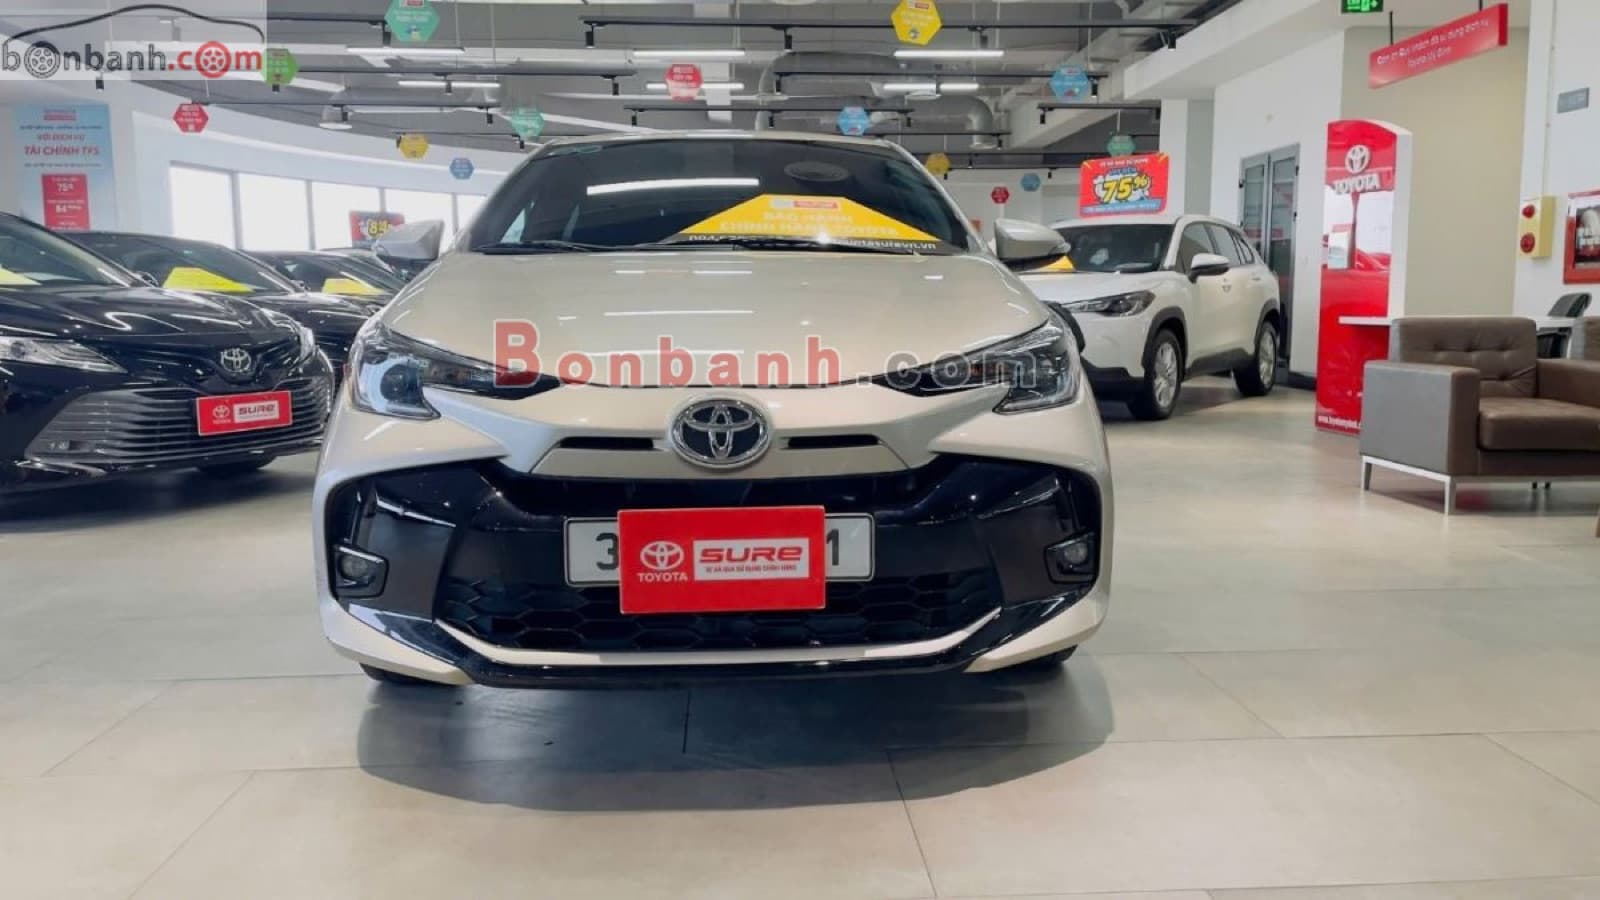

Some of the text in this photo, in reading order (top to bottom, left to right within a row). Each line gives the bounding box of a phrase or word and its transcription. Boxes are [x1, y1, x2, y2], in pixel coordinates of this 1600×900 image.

[1102, 174, 1149, 205] 75%
[1332, 172, 1381, 195] TOYOTA
[637, 570, 688, 583] TOYOTA
